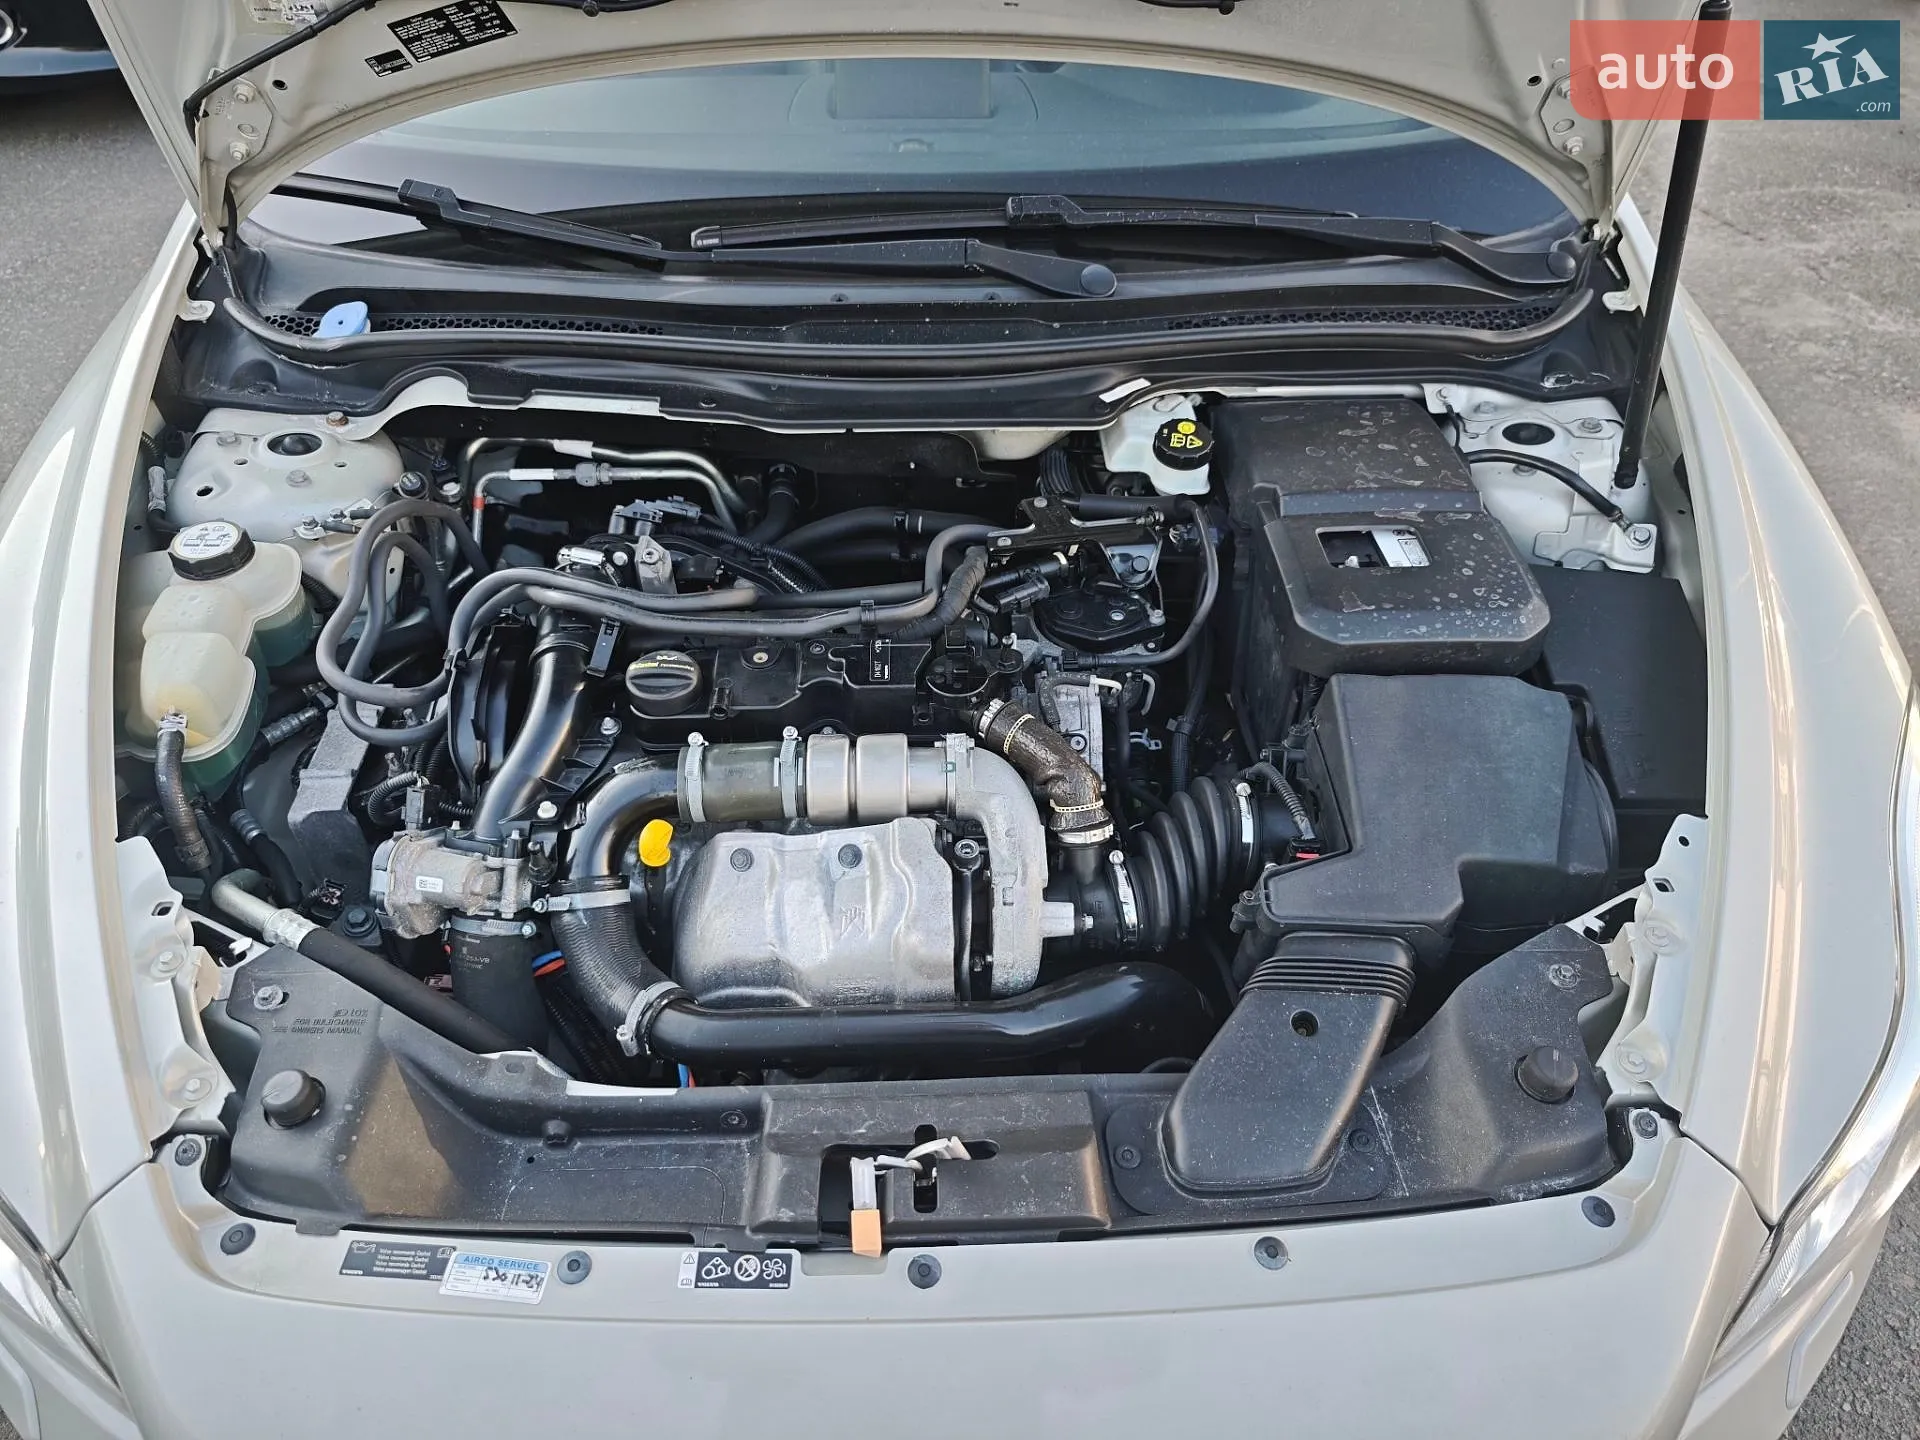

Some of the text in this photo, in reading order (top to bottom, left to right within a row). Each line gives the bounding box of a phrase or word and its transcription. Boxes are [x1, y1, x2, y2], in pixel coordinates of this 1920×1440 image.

[326, 1026, 361, 1034] MANUAL
[463, 1255, 540, 1270] AIRCO SERVICE
